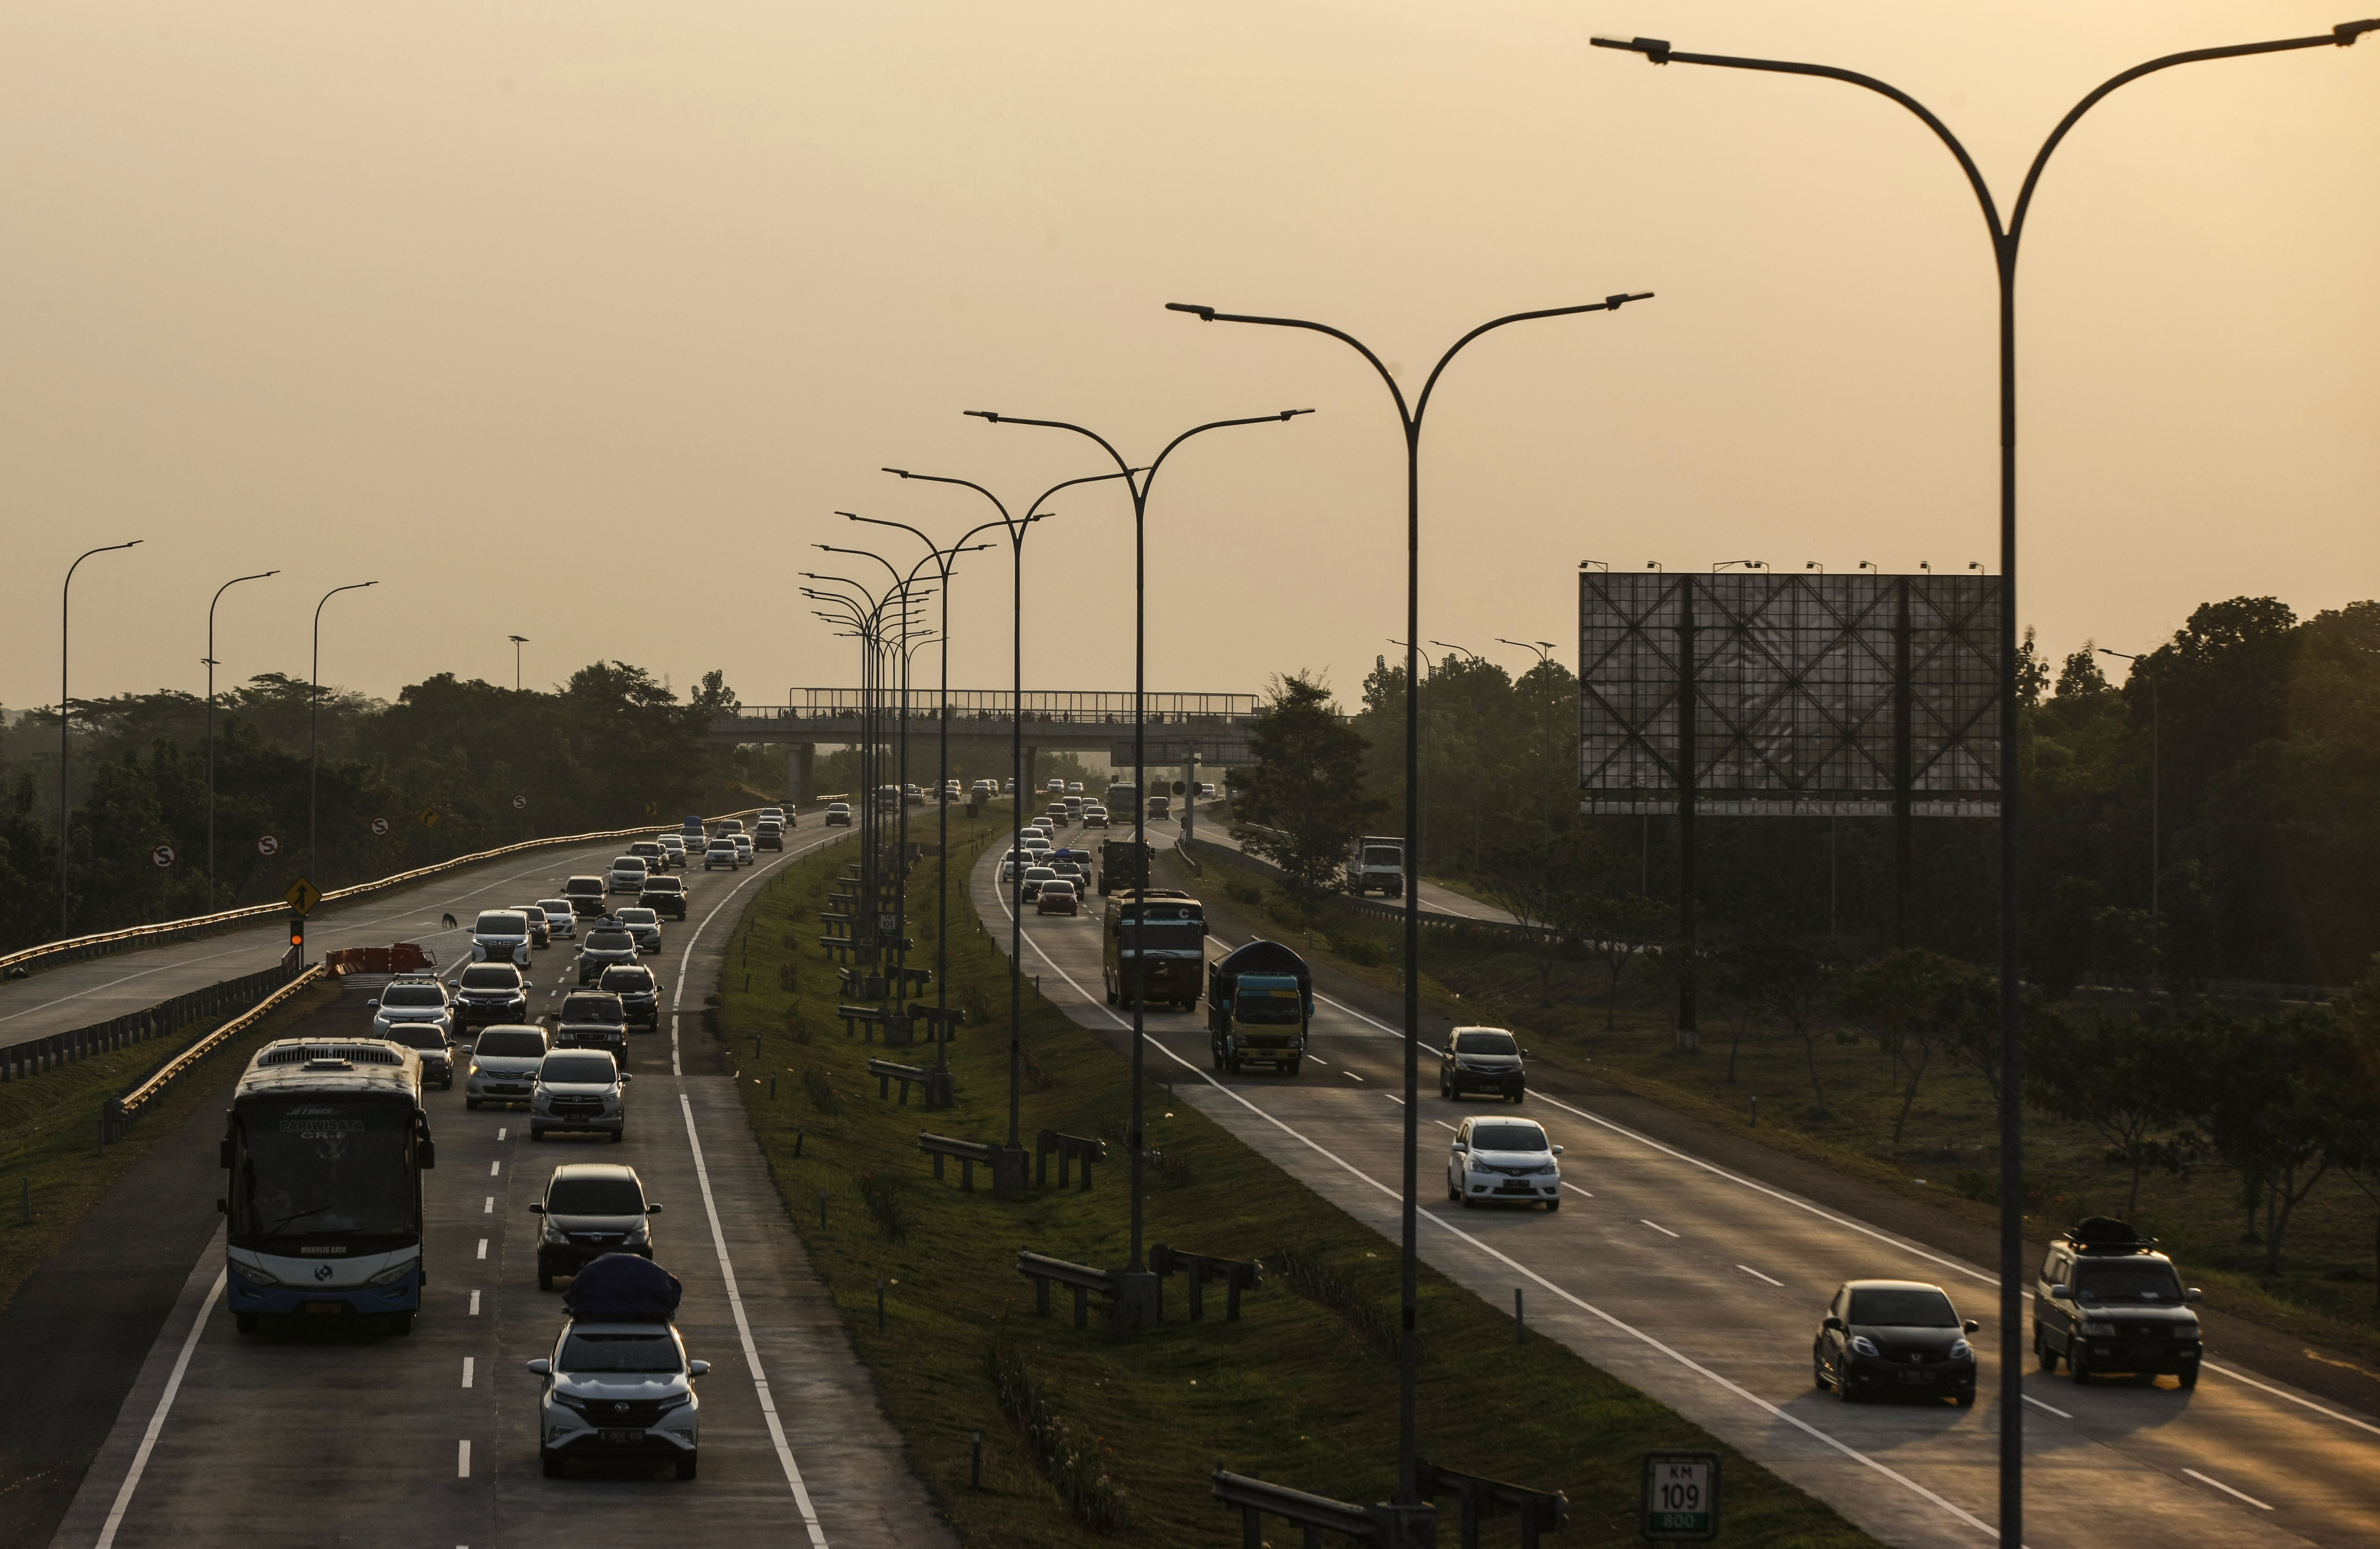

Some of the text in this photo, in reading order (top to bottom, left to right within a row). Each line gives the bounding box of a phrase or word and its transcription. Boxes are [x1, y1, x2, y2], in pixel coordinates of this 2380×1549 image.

[1179, 908, 1190, 919] C
[280, 1119, 364, 1132] PARIWISATA
[1670, 1466, 1692, 1478] KM
[1661, 1483, 1699, 1509] 109
[1663, 1513, 1696, 1528] 800
